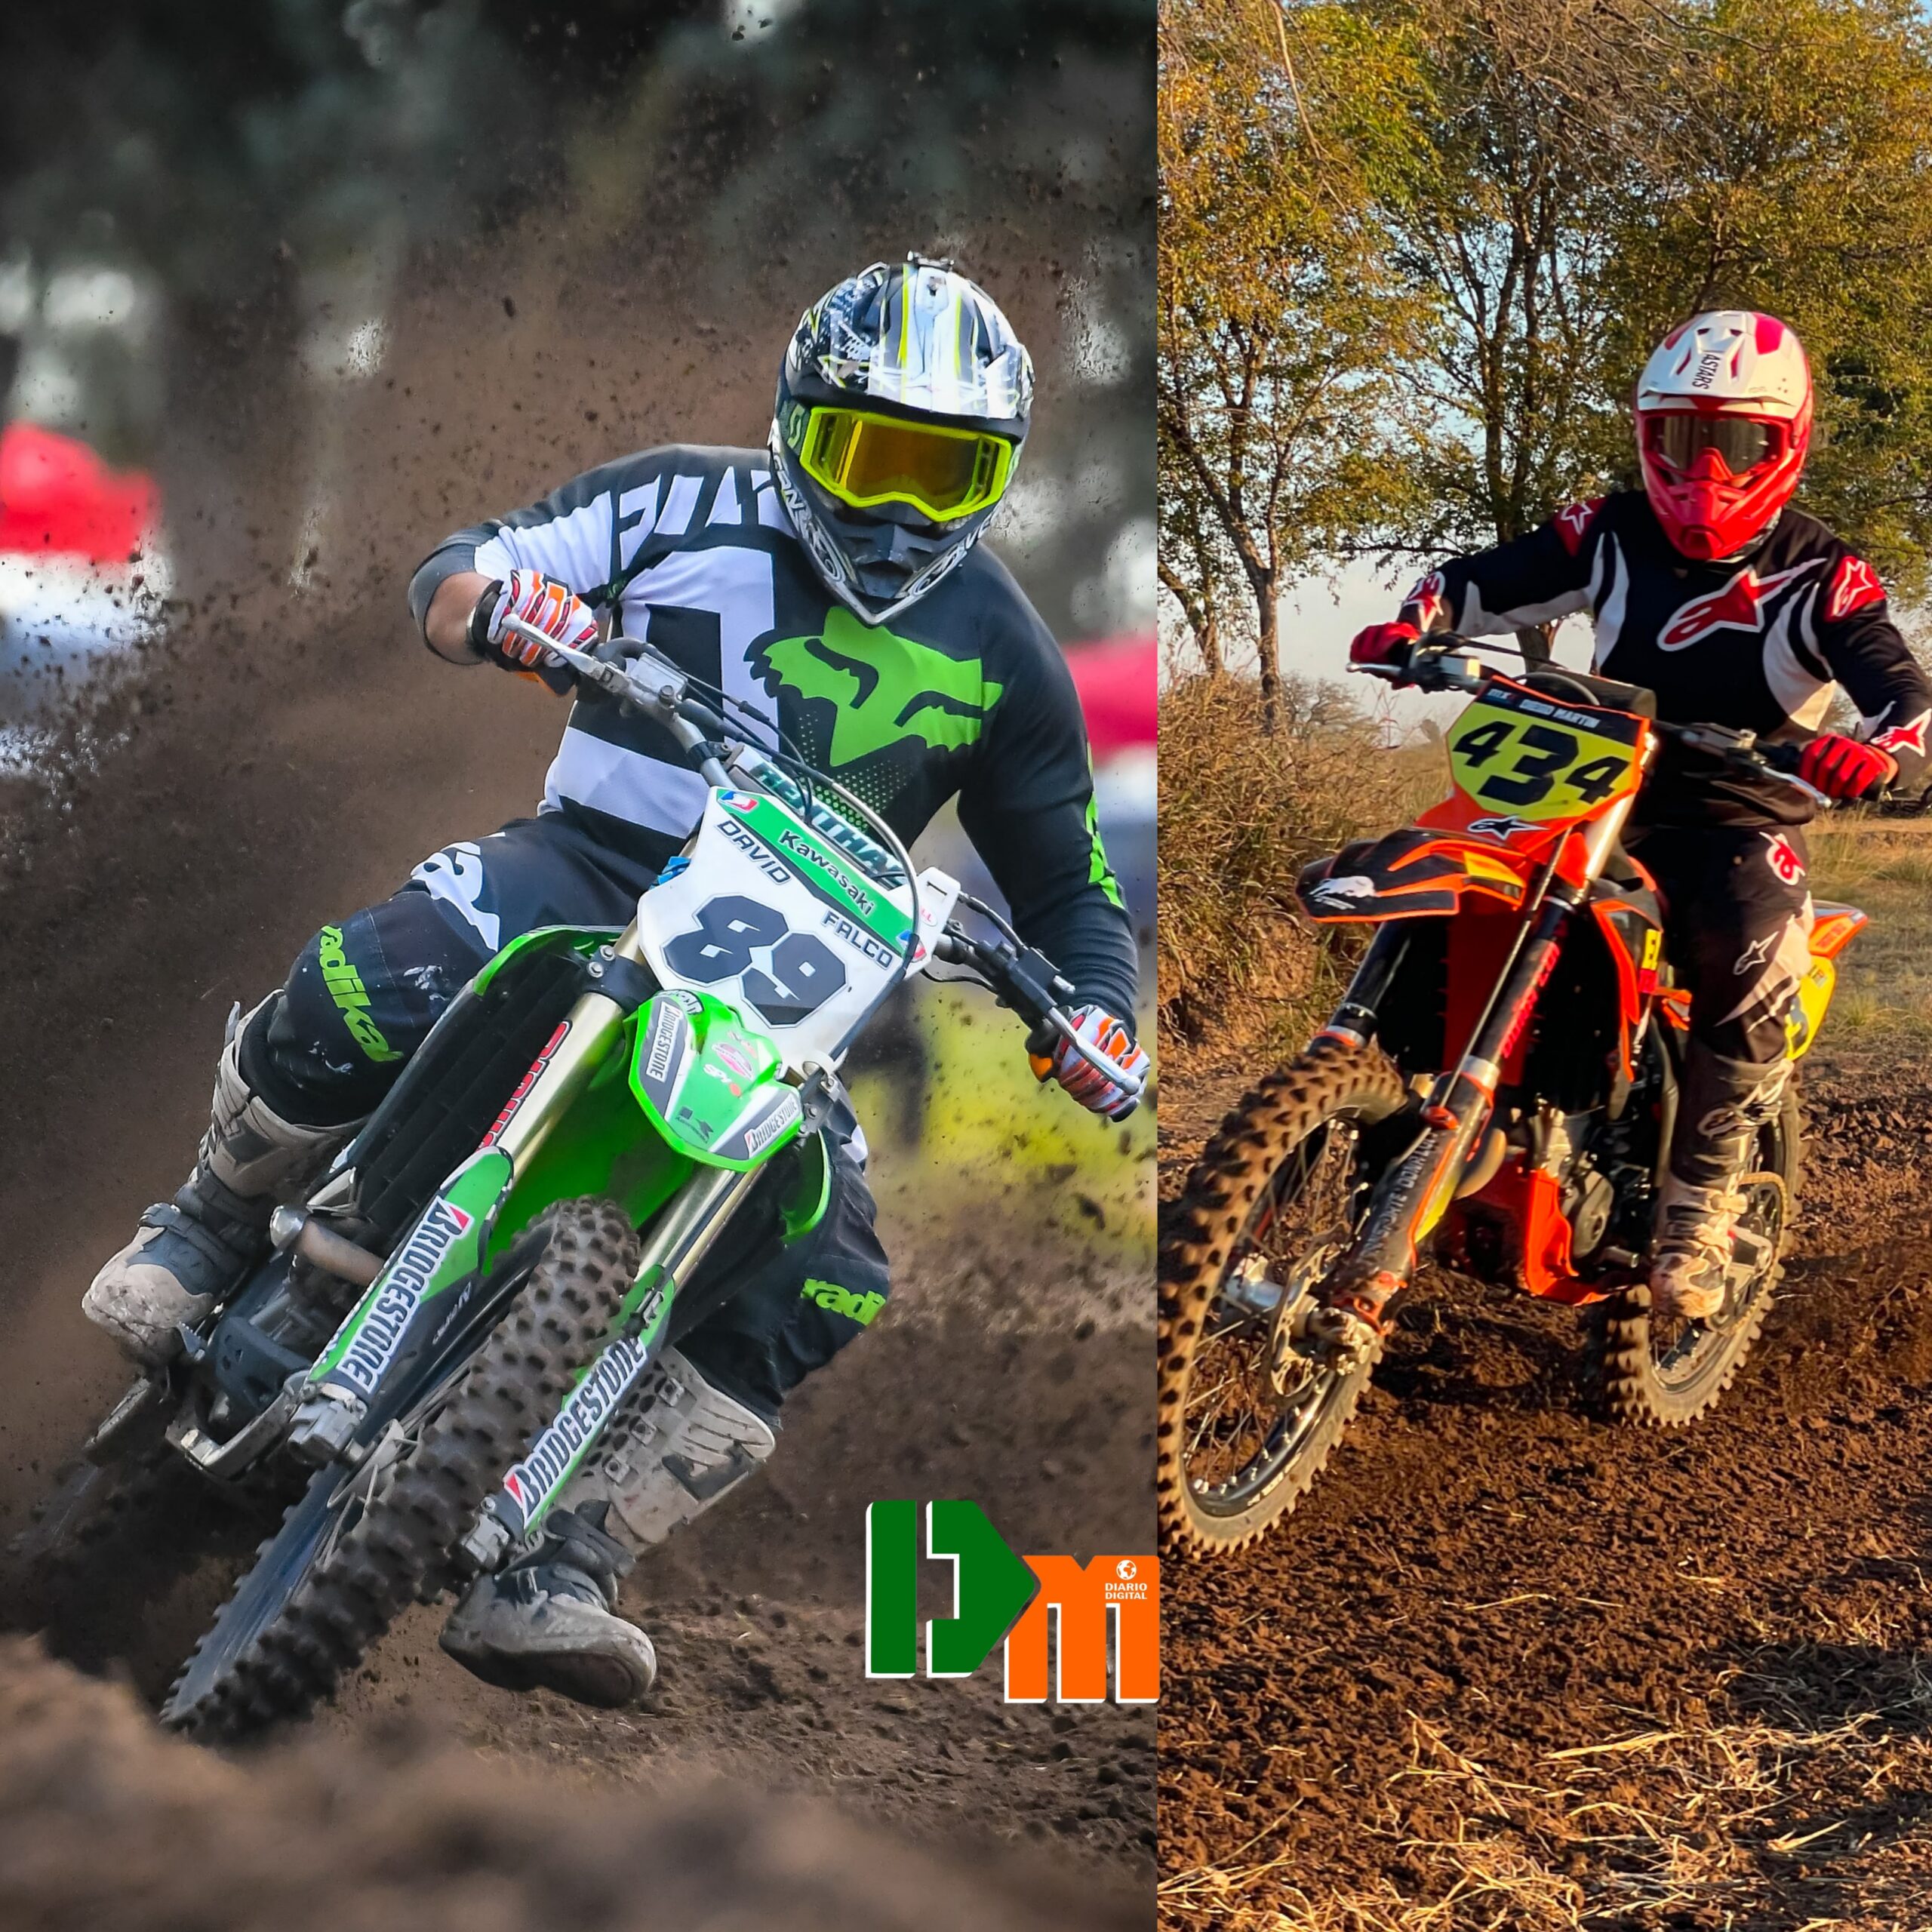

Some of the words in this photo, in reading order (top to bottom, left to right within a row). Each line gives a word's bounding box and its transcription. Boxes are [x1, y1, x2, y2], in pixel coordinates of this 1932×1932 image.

[1692, 353, 1723, 389] ASTARS
[1453, 721, 1632, 806] 434
[717, 820, 792, 885] DAVID
[778, 829, 875, 916] Kawasaki
[662, 895, 848, 1028] 89
[822, 910, 894, 971] FALCO
[319, 925, 403, 1062] radikal
[649, 1004, 681, 1080] BRIDGESTONE
[745, 1098, 798, 1157] BRIDGESTONE
[340, 1196, 472, 1392] BRIDGESTONE
[507, 1339, 646, 1524] BRIDGESTONE
